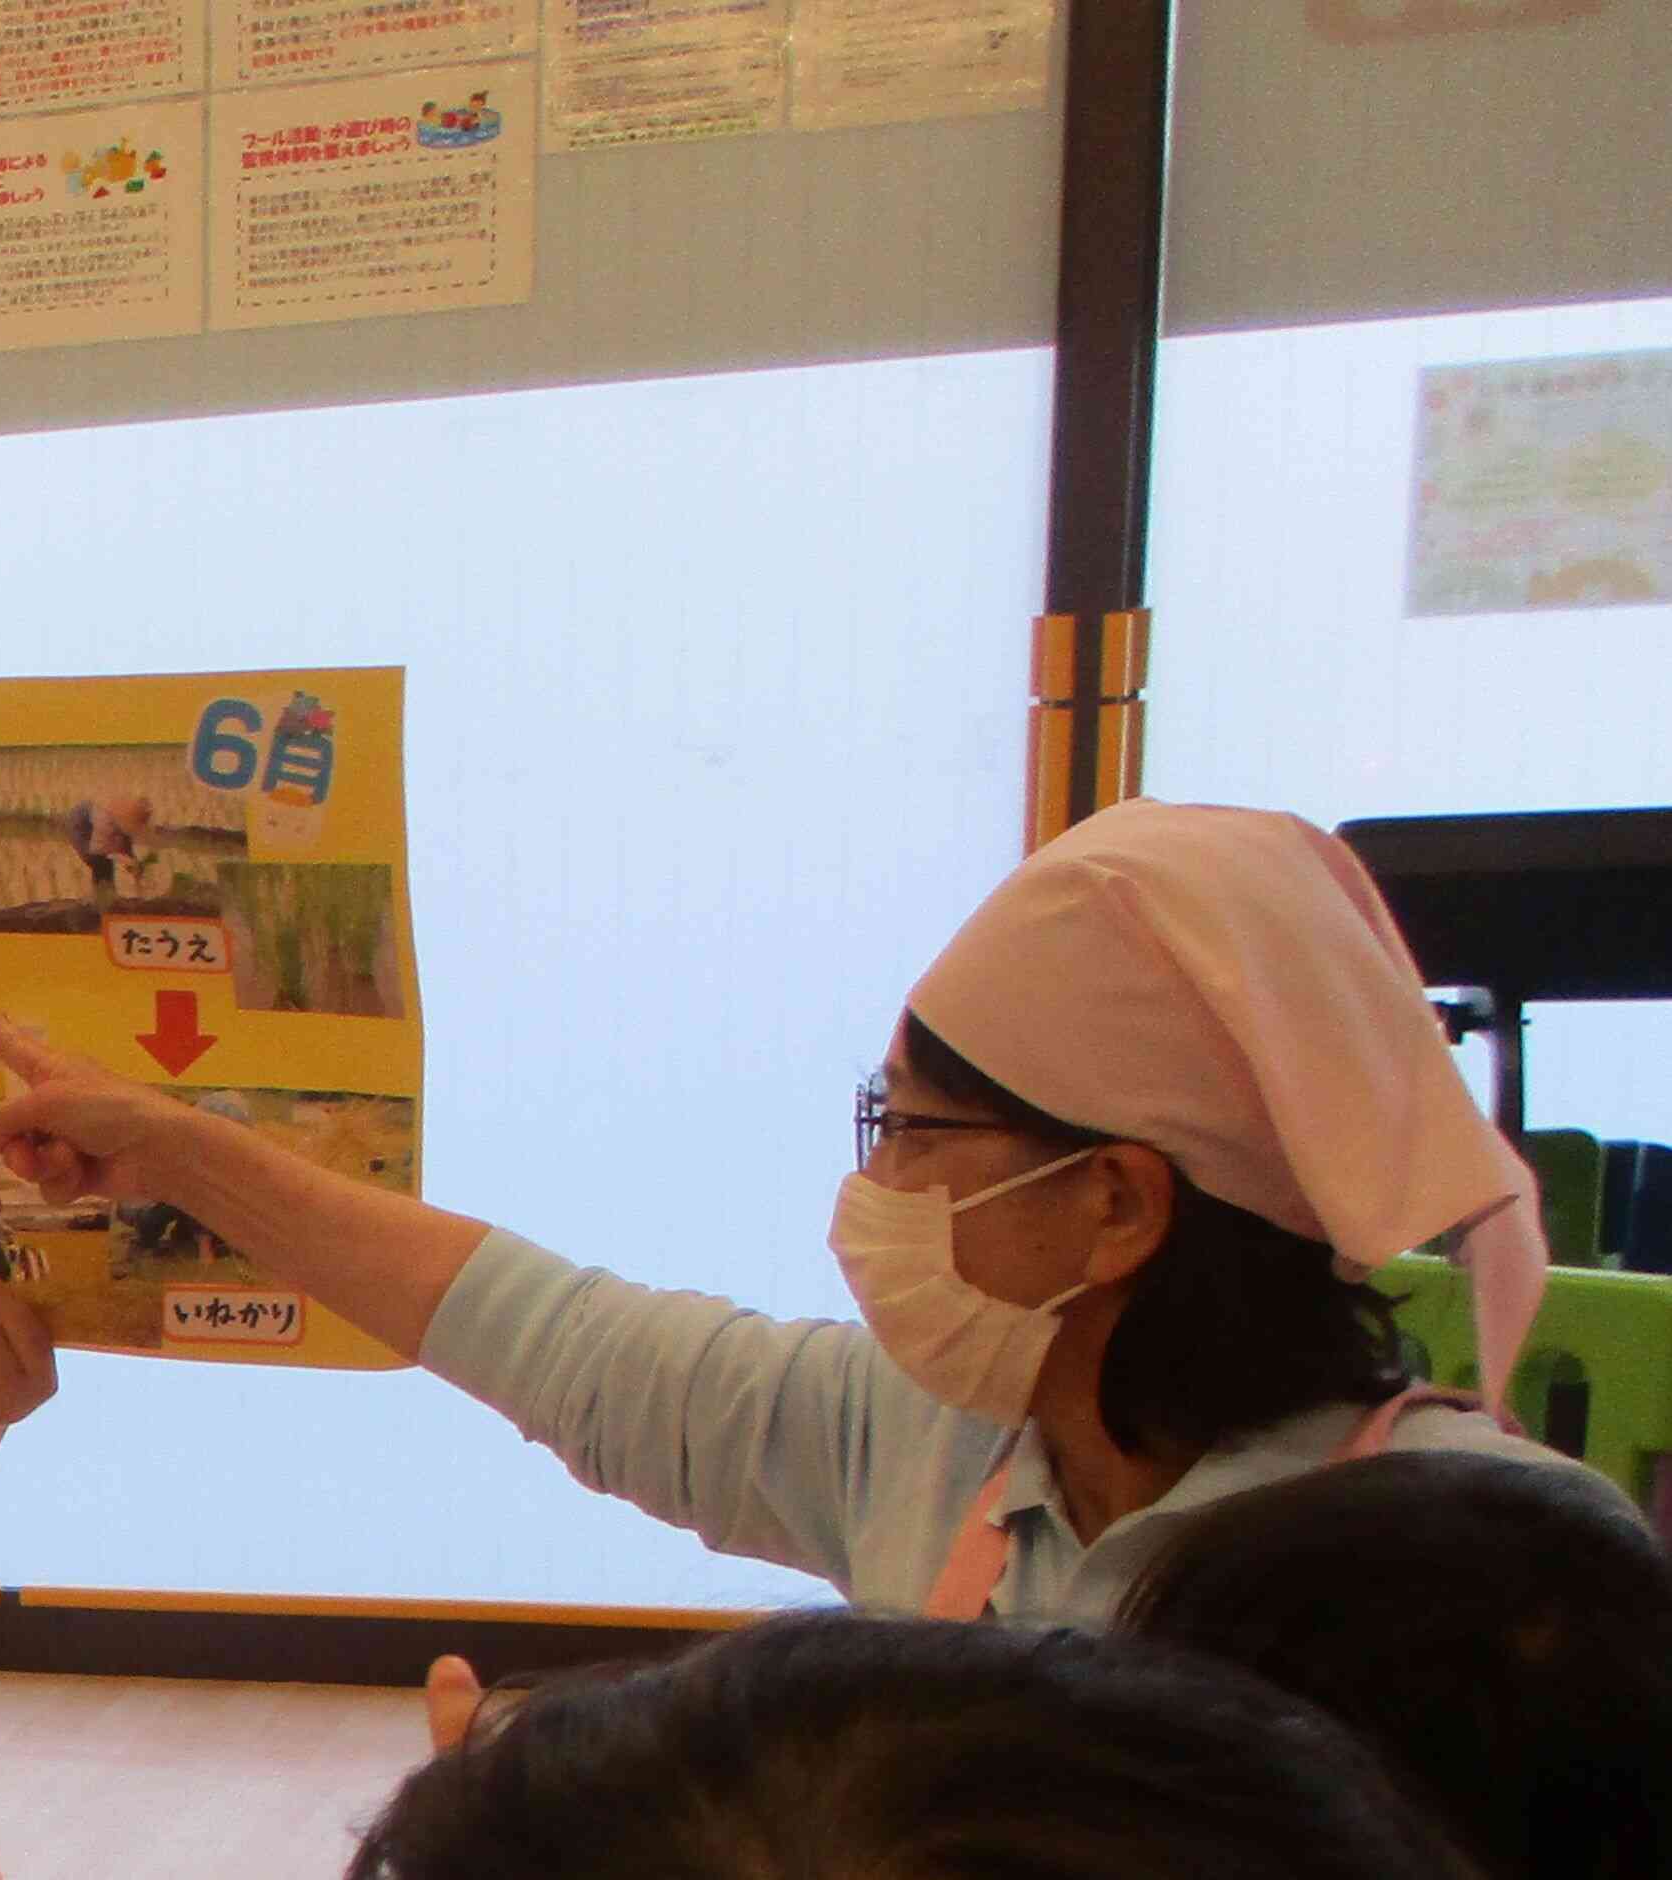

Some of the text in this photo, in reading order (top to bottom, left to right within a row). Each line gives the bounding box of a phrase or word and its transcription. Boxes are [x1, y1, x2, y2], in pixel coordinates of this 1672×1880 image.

[192, 699, 334, 806] 6月
[121, 928, 216, 963] たうえ
[173, 1296, 295, 1335] いねかり
